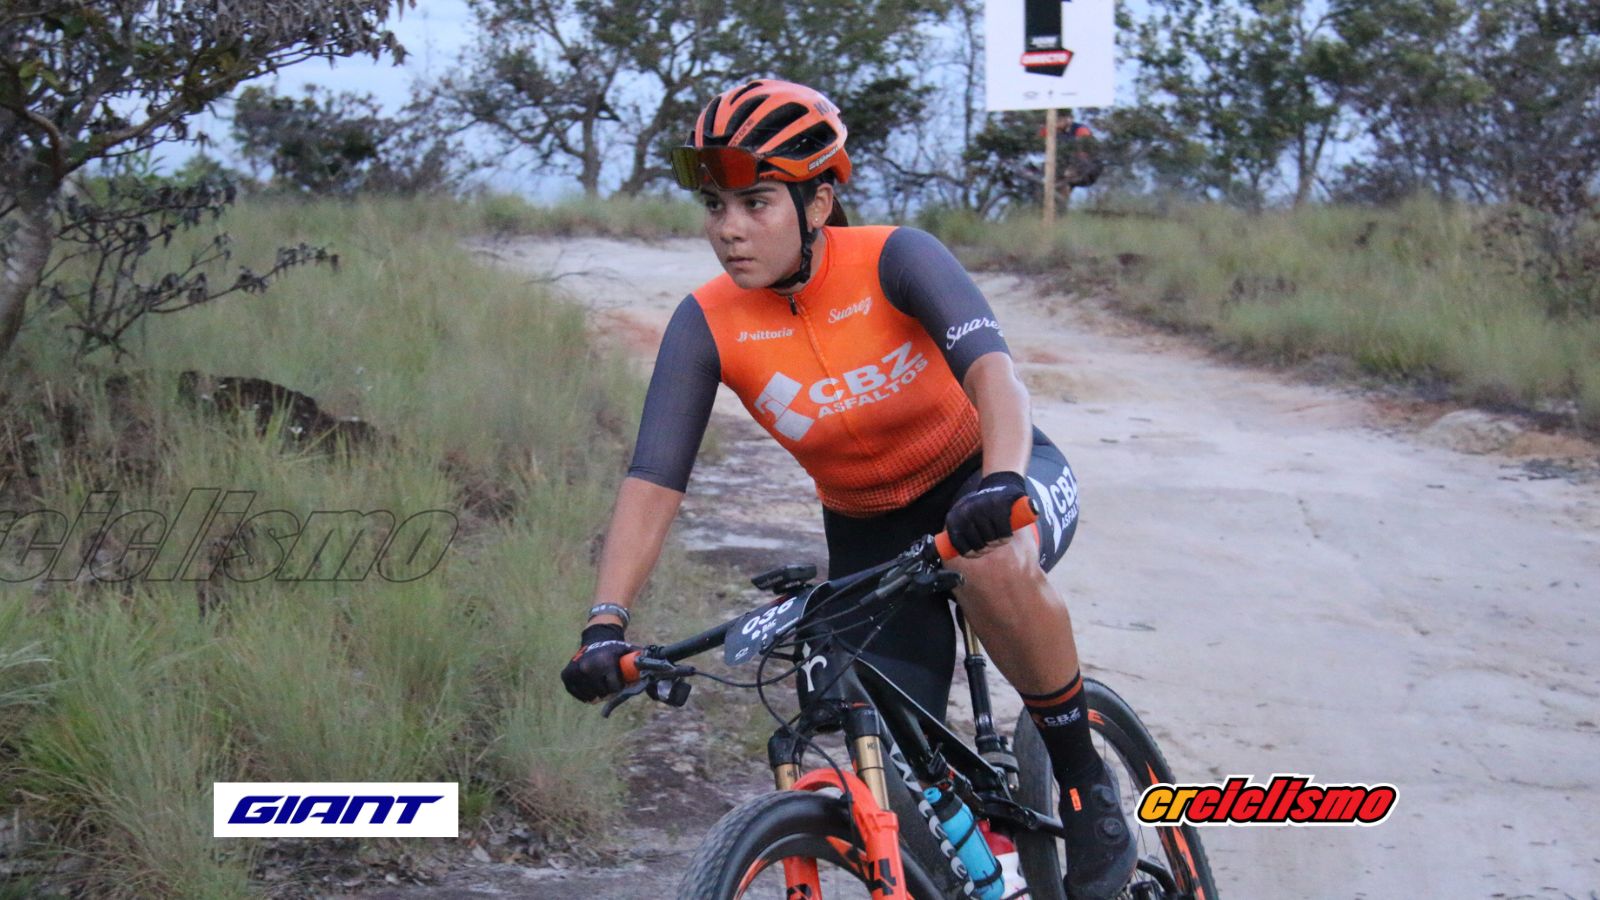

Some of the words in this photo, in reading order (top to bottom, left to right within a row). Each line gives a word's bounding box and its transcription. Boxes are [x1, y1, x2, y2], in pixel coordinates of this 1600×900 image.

[827, 295, 873, 324] Suarez
[808, 340, 923, 406] CBZ
[816, 357, 929, 420] ASFALTOS
